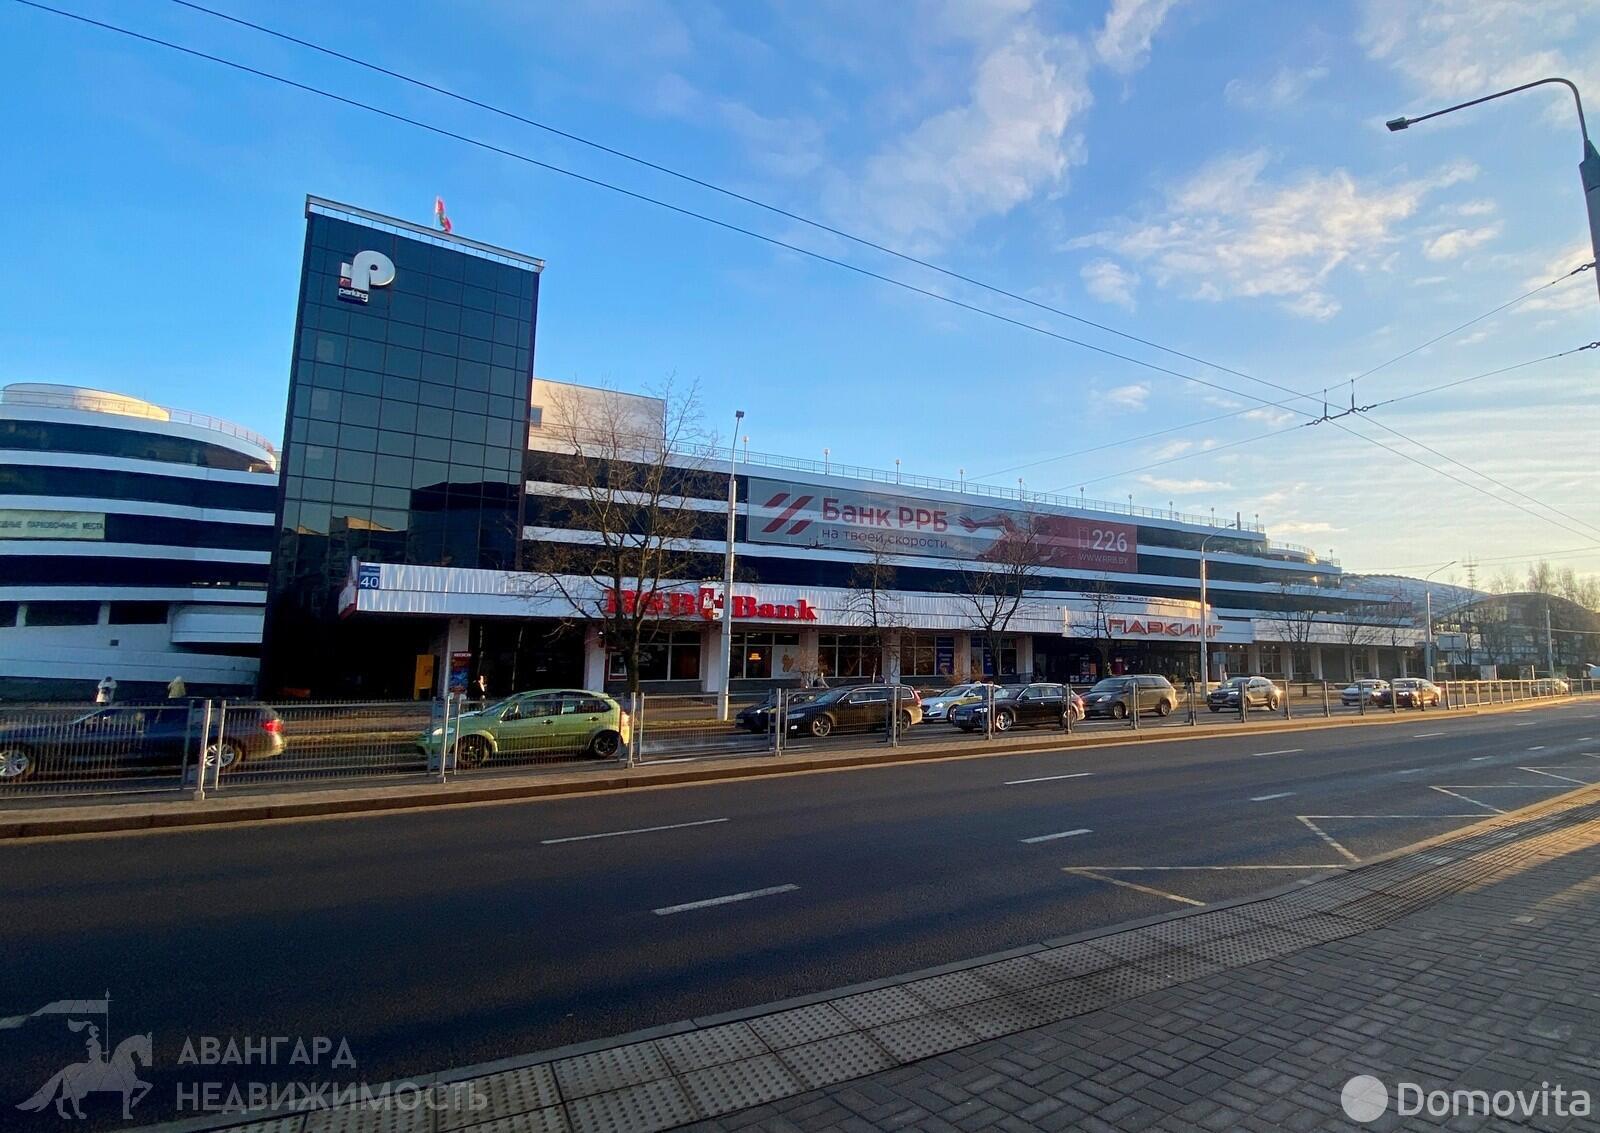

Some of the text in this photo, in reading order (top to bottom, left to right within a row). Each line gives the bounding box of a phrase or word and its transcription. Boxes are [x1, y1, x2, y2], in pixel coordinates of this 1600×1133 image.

[338, 288, 369, 303] parking
[822, 497, 948, 532] Банк РРБ
[82, 522, 104, 530] МЕСТА
[822, 528, 948, 549] на твоей скорости
[1092, 529, 1128, 552] 226
[360, 576, 379, 588] 40
[731, 595, 818, 621] Bank
[1107, 619, 1223, 637] ПАРКИНГ
